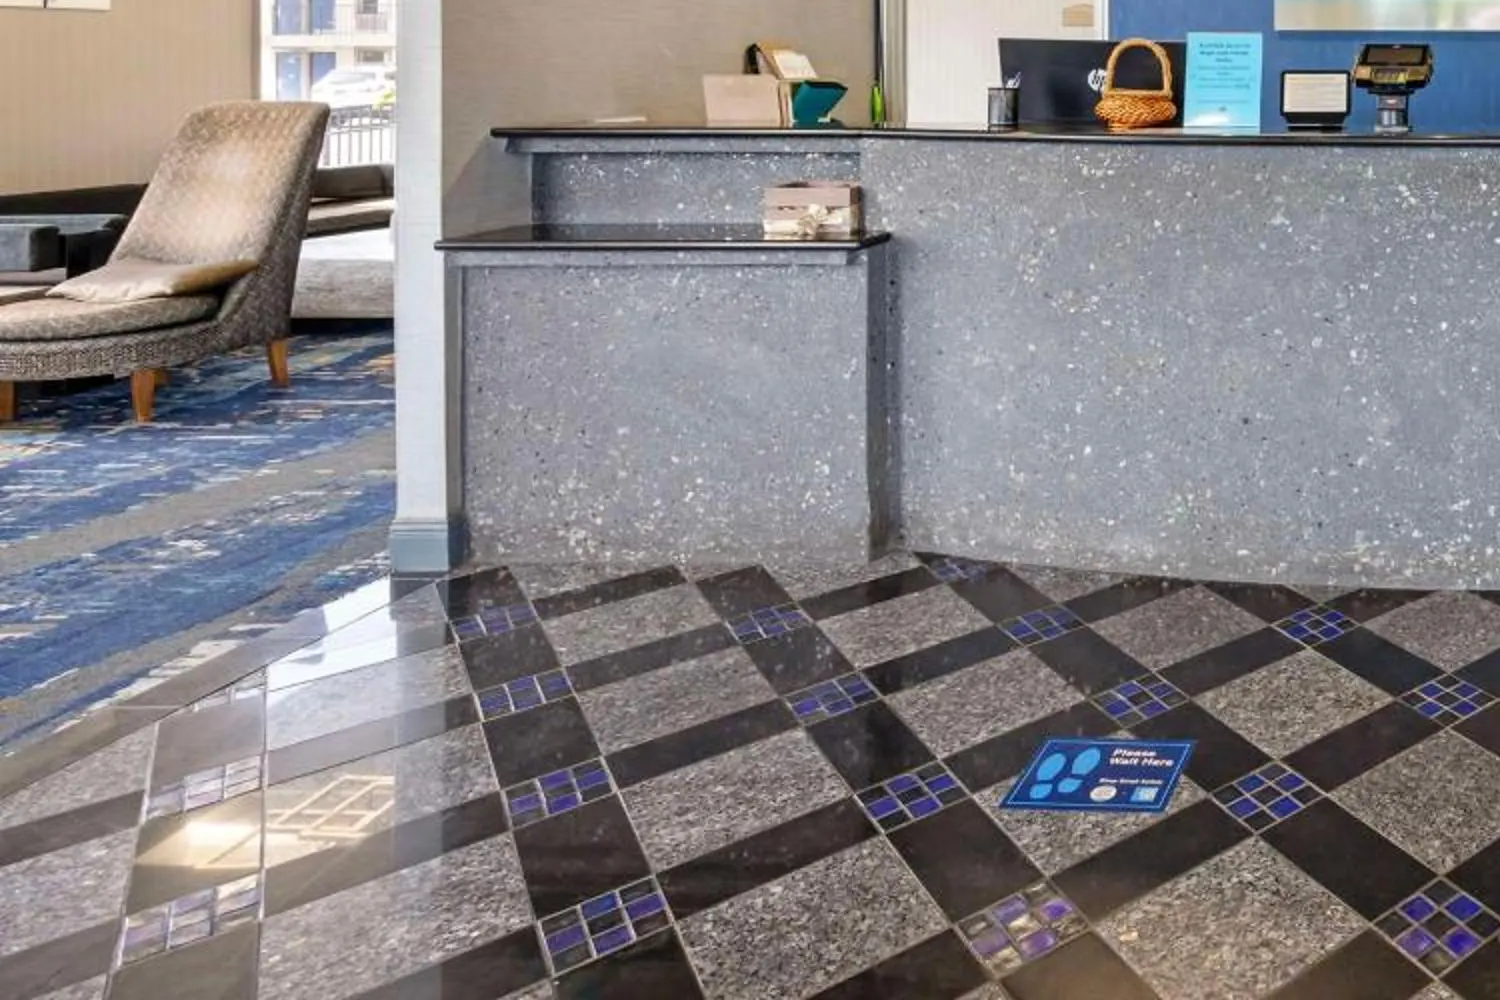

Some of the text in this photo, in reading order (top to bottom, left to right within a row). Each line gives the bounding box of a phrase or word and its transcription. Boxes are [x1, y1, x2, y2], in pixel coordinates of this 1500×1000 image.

[1113, 748, 1156, 757] Please
[1110, 757, 1174, 766] Wait Here
